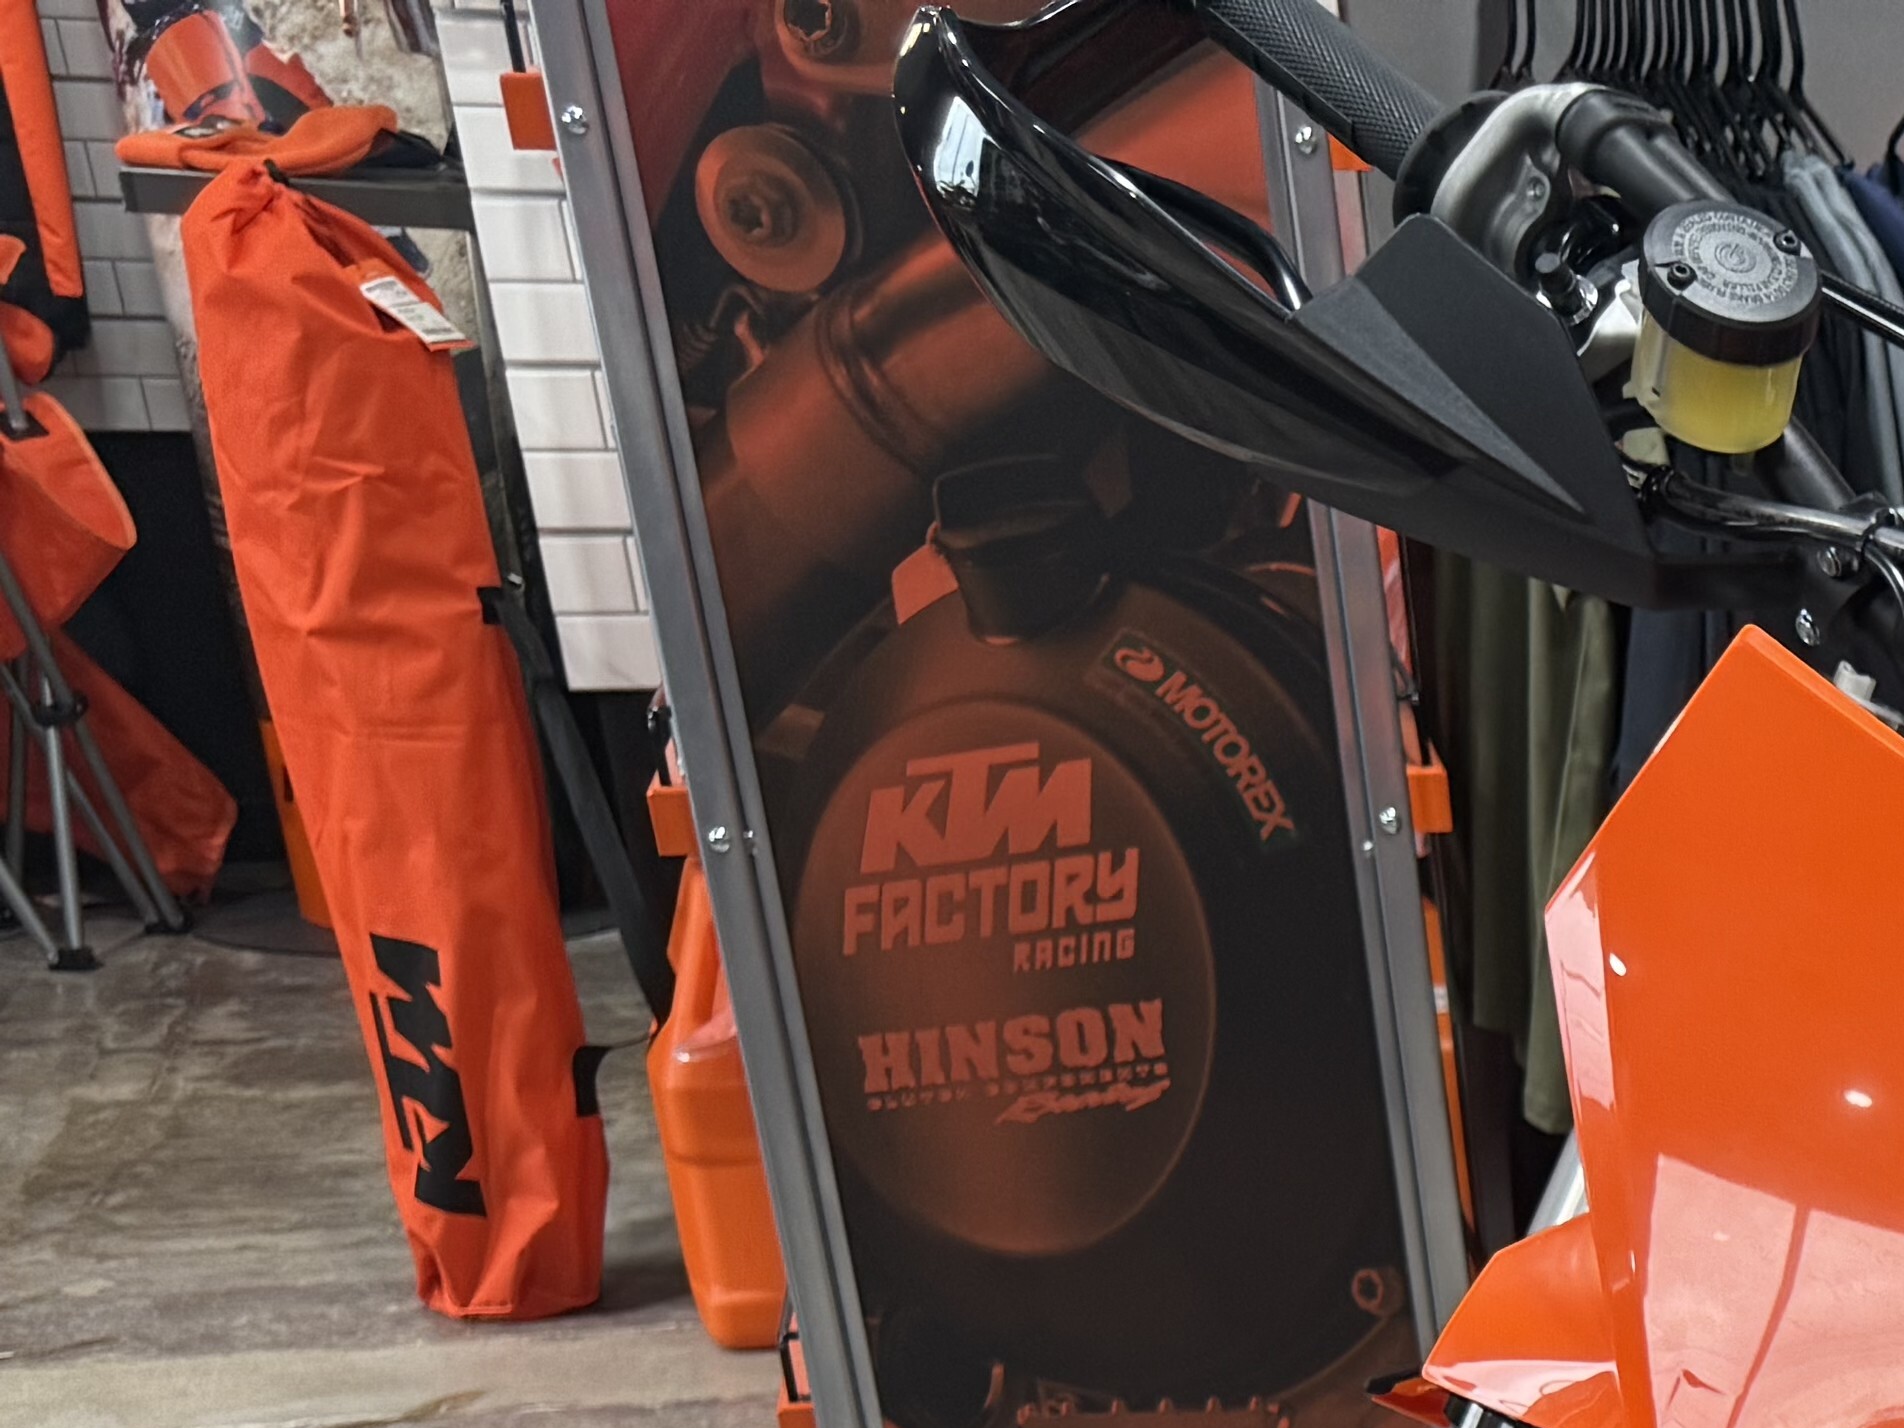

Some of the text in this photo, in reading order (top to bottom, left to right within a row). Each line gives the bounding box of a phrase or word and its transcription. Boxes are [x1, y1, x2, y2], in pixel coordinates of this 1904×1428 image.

[860, 742, 1092, 875] KTM
[1155, 670, 1295, 841] MOTOREX
[843, 847, 1140, 957] FACTORY
[1014, 927, 1136, 973] RACING
[369, 932, 487, 1219] KTM
[858, 997, 1166, 1094] HINSON
